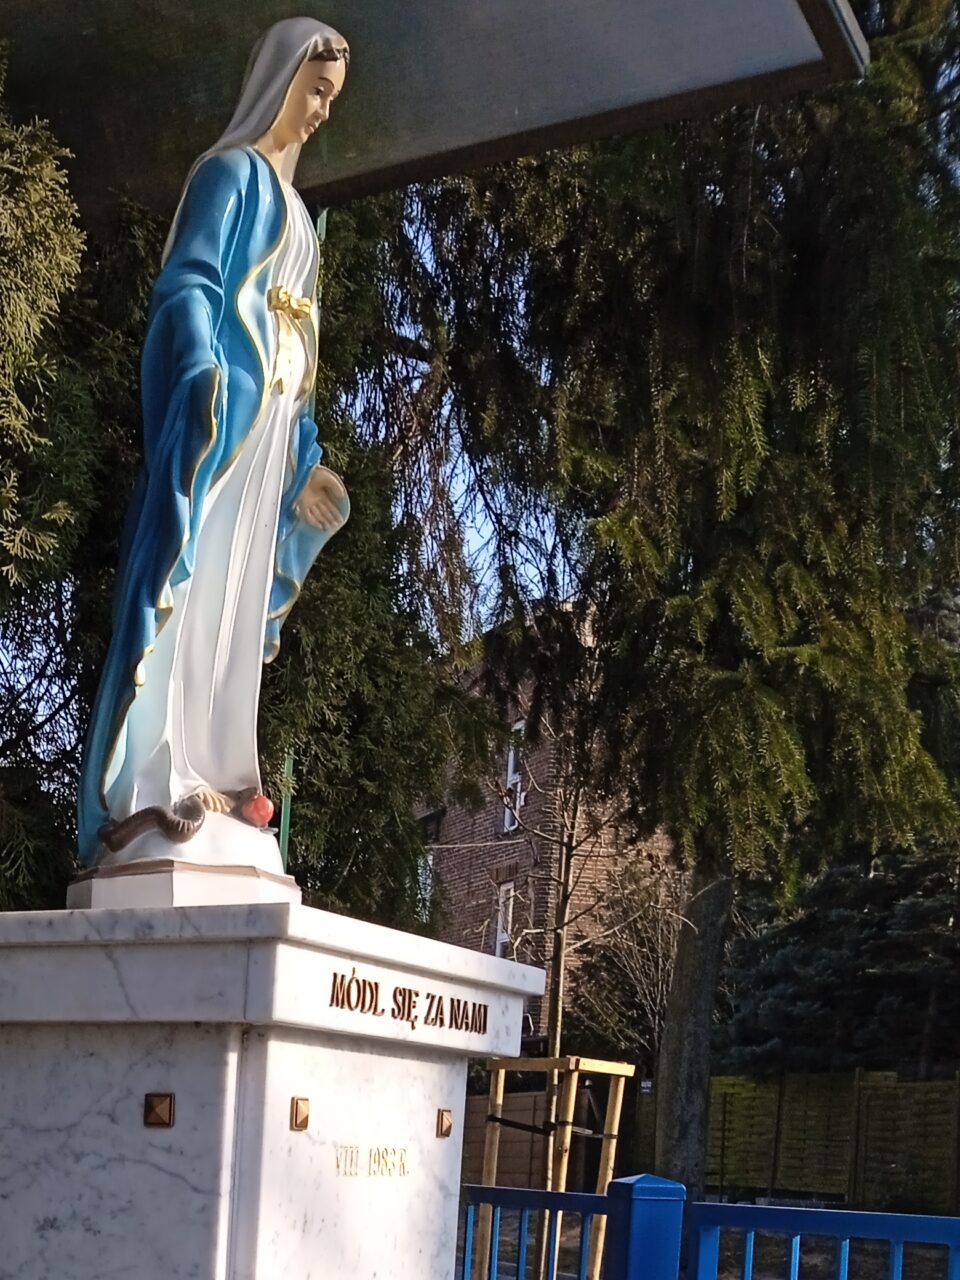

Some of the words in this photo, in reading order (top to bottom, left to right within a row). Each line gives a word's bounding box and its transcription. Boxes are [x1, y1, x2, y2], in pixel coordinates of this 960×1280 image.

[329, 967, 385, 1017] MÓDL
[391, 986, 419, 1030] SIĘ
[424, 992, 445, 1028] ZA
[449, 997, 489, 1035] NAMI
[335, 1146, 359, 1177] VIII
